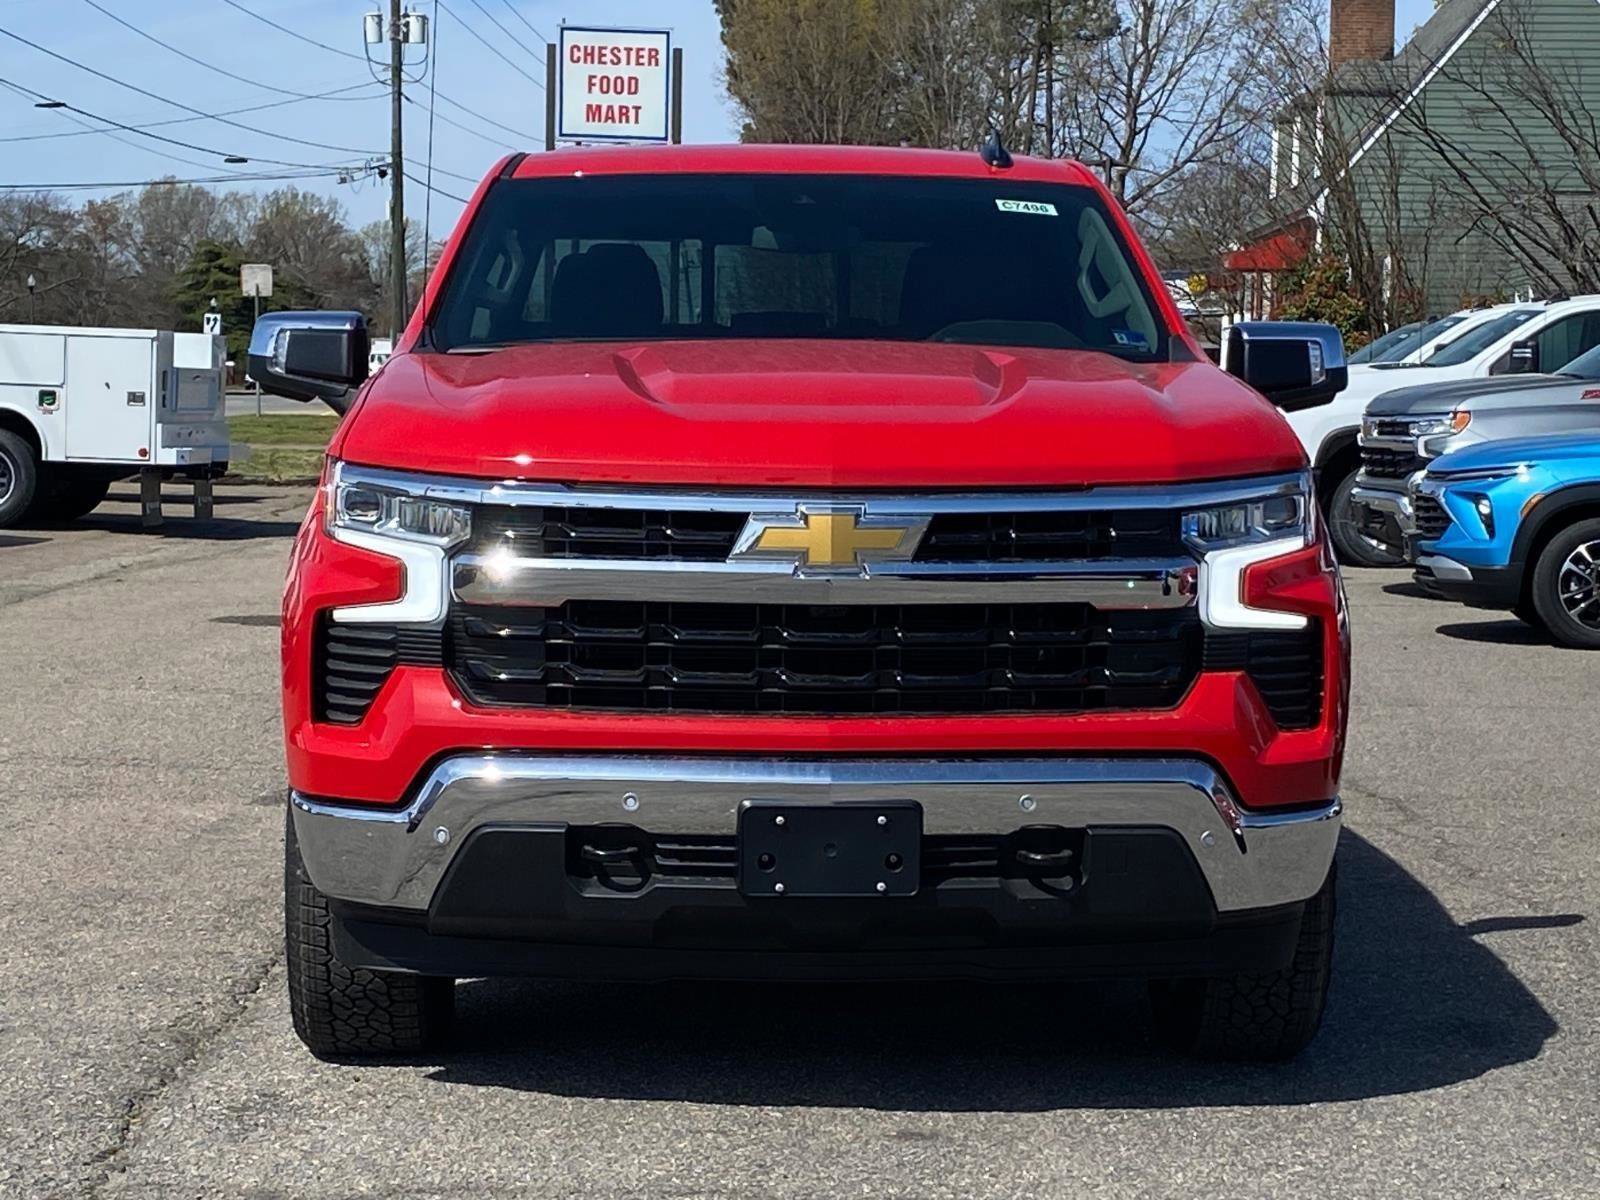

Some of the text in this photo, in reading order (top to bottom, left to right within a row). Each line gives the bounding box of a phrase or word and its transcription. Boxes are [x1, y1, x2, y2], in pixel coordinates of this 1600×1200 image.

[569, 44, 660, 67] CHESTER
[587, 74, 640, 95] FOOD
[585, 103, 642, 124] MART
